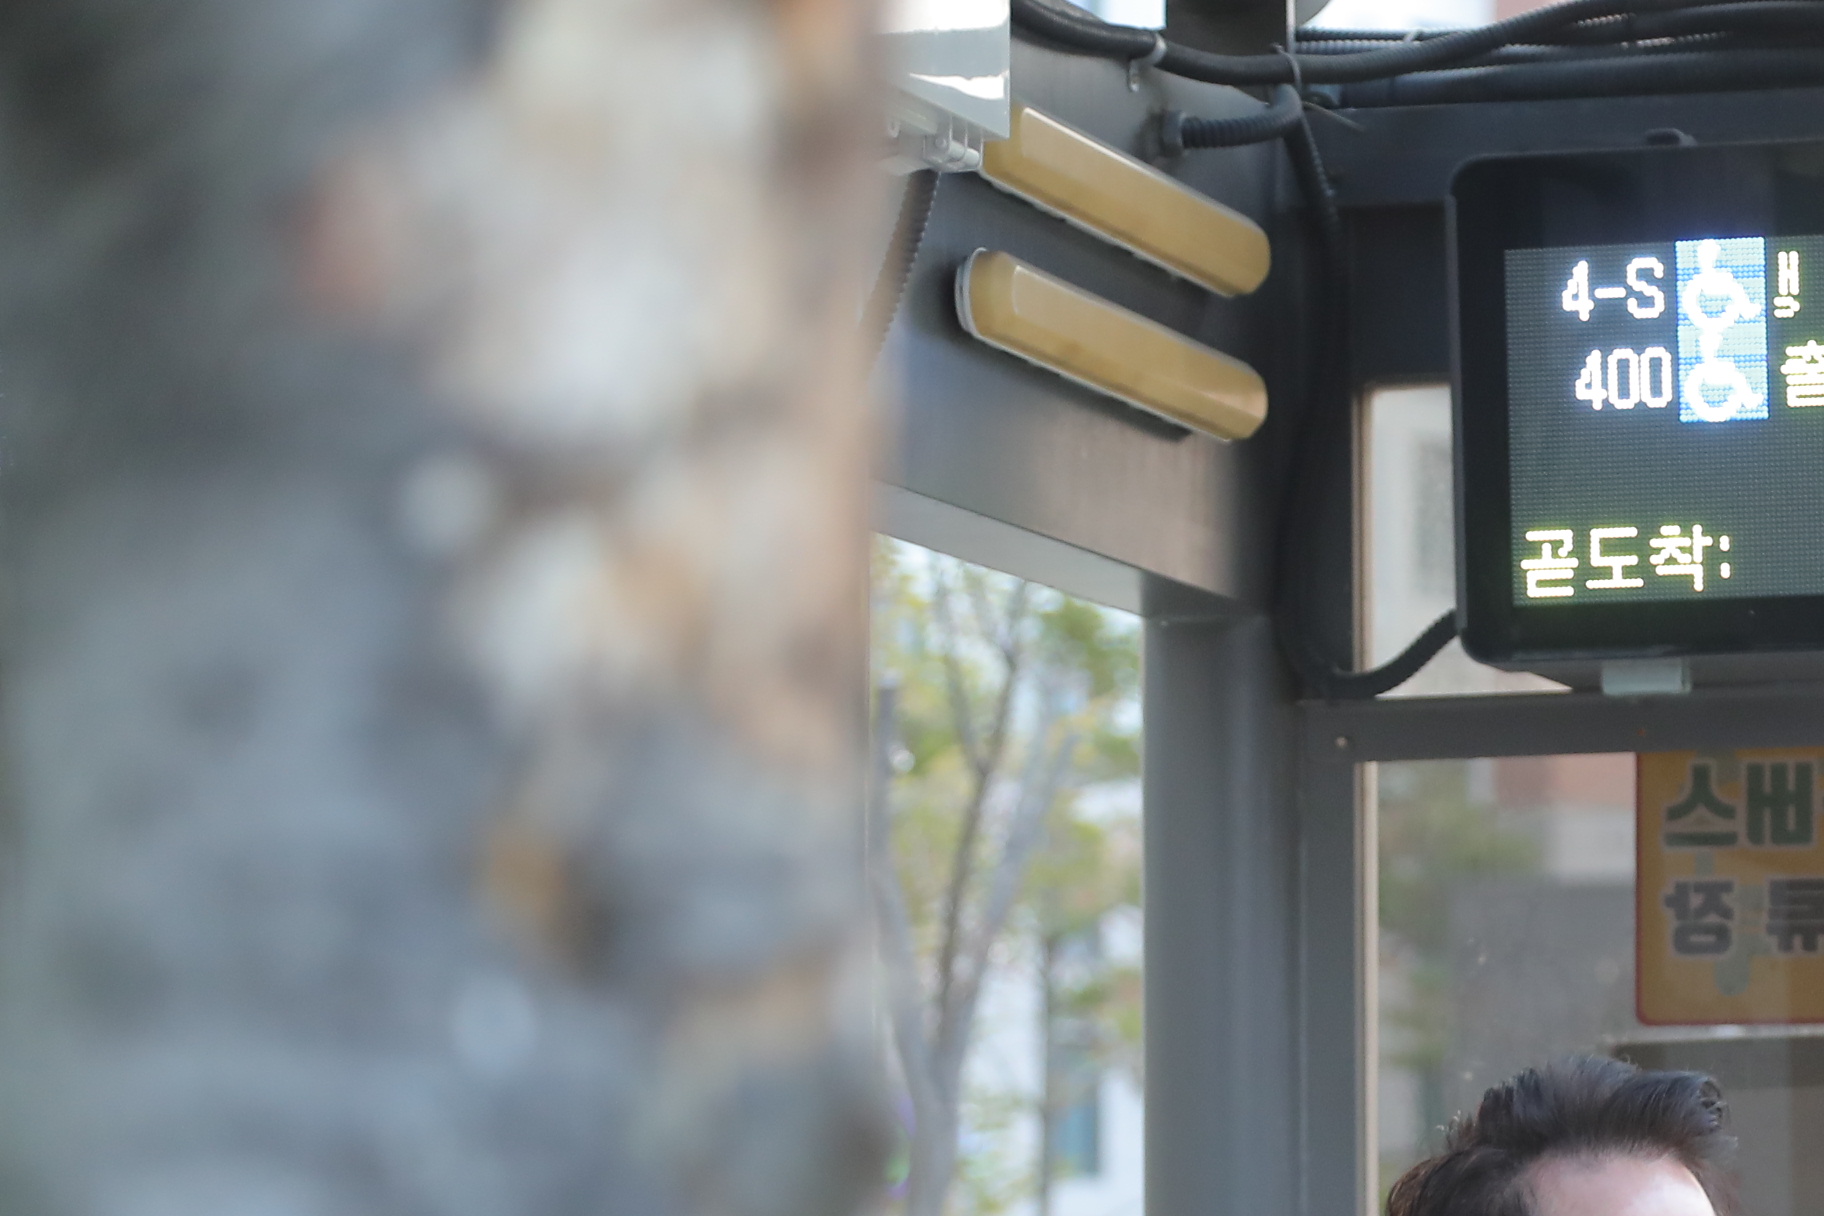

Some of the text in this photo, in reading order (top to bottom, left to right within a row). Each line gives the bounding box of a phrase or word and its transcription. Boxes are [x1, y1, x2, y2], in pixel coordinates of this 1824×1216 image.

[1560, 256, 1666, 323] 4-S
[1574, 345, 1674, 412] 400
[1519, 523, 1732, 599] 곧도착:
